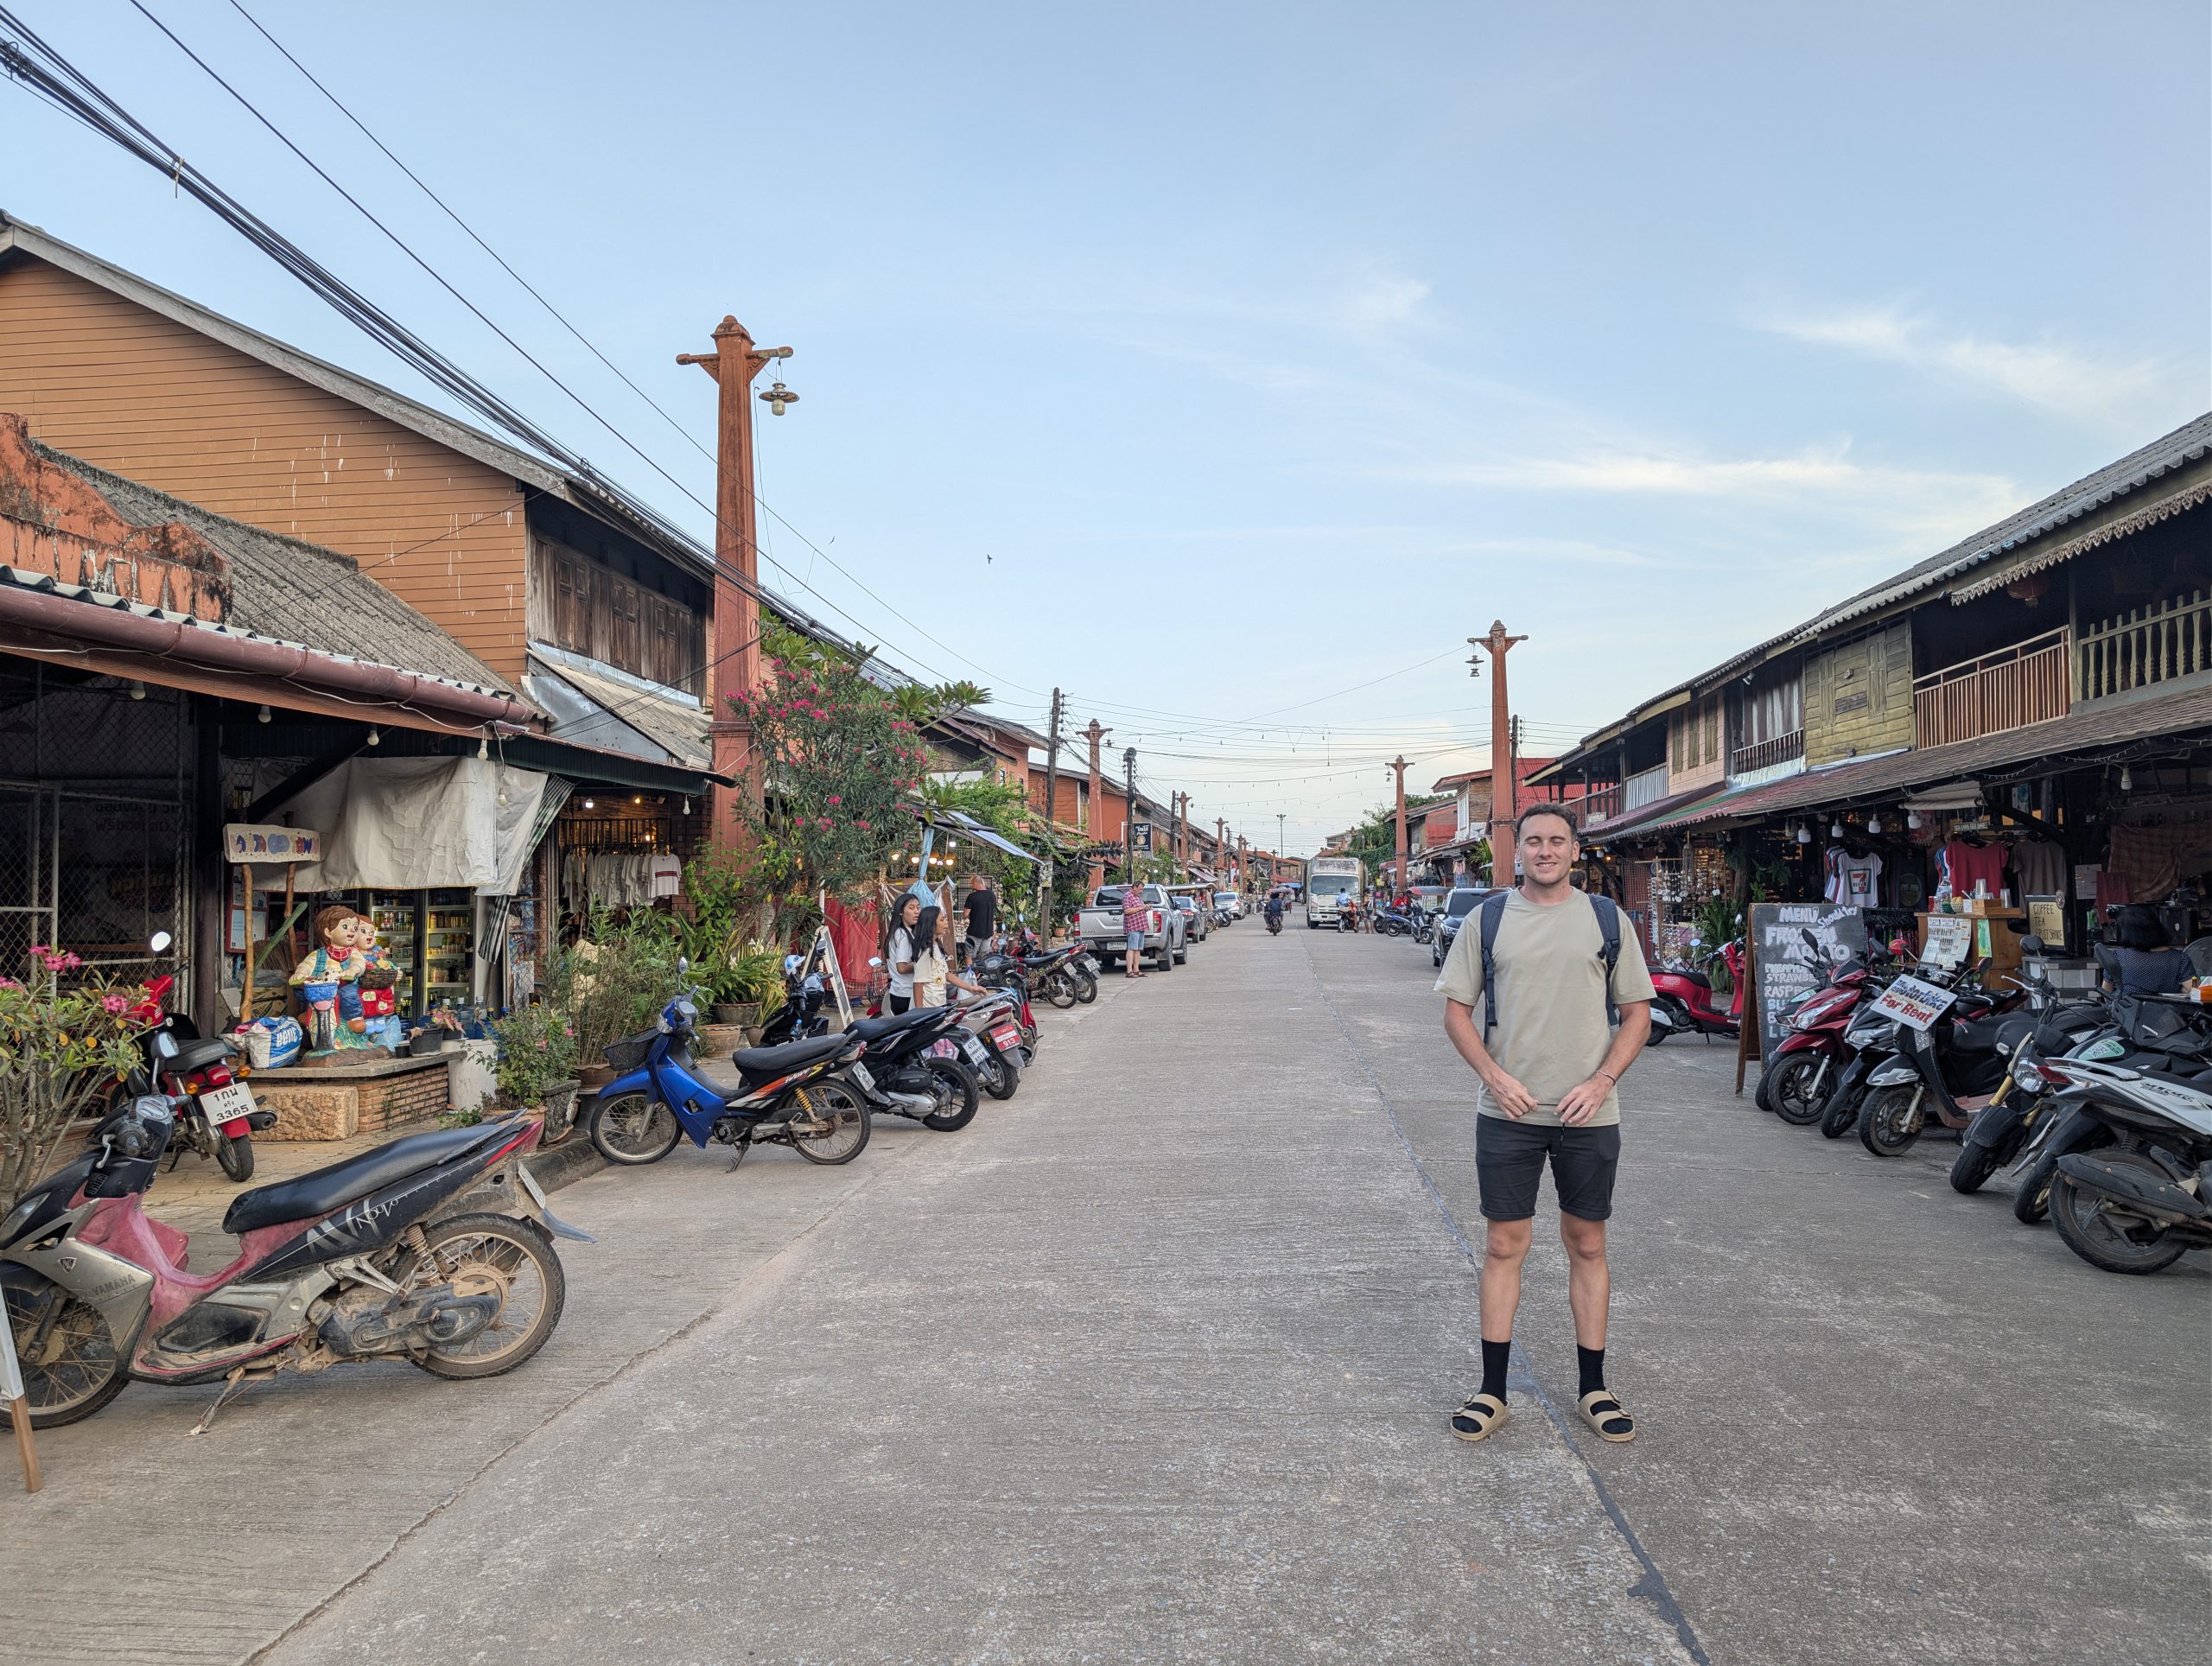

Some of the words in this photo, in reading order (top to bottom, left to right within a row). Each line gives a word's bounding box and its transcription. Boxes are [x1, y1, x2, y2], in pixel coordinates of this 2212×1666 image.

[290, 834, 320, 855] TOWN
[1779, 906, 1820, 923] MENU
[2032, 903, 2055, 915] COFFEE
[2033, 916, 2046, 926] TEA
[1783, 944, 1850, 967] MOTO
[1879, 994, 1902, 1009] For
[1900, 1002, 1934, 1024] Rent
[1002, 1037, 1016, 1047] 913
[213, 1088, 238, 1102] 1กน
[216, 1103, 249, 1122] 3365
[92, 1273, 136, 1296] YAMAHA
